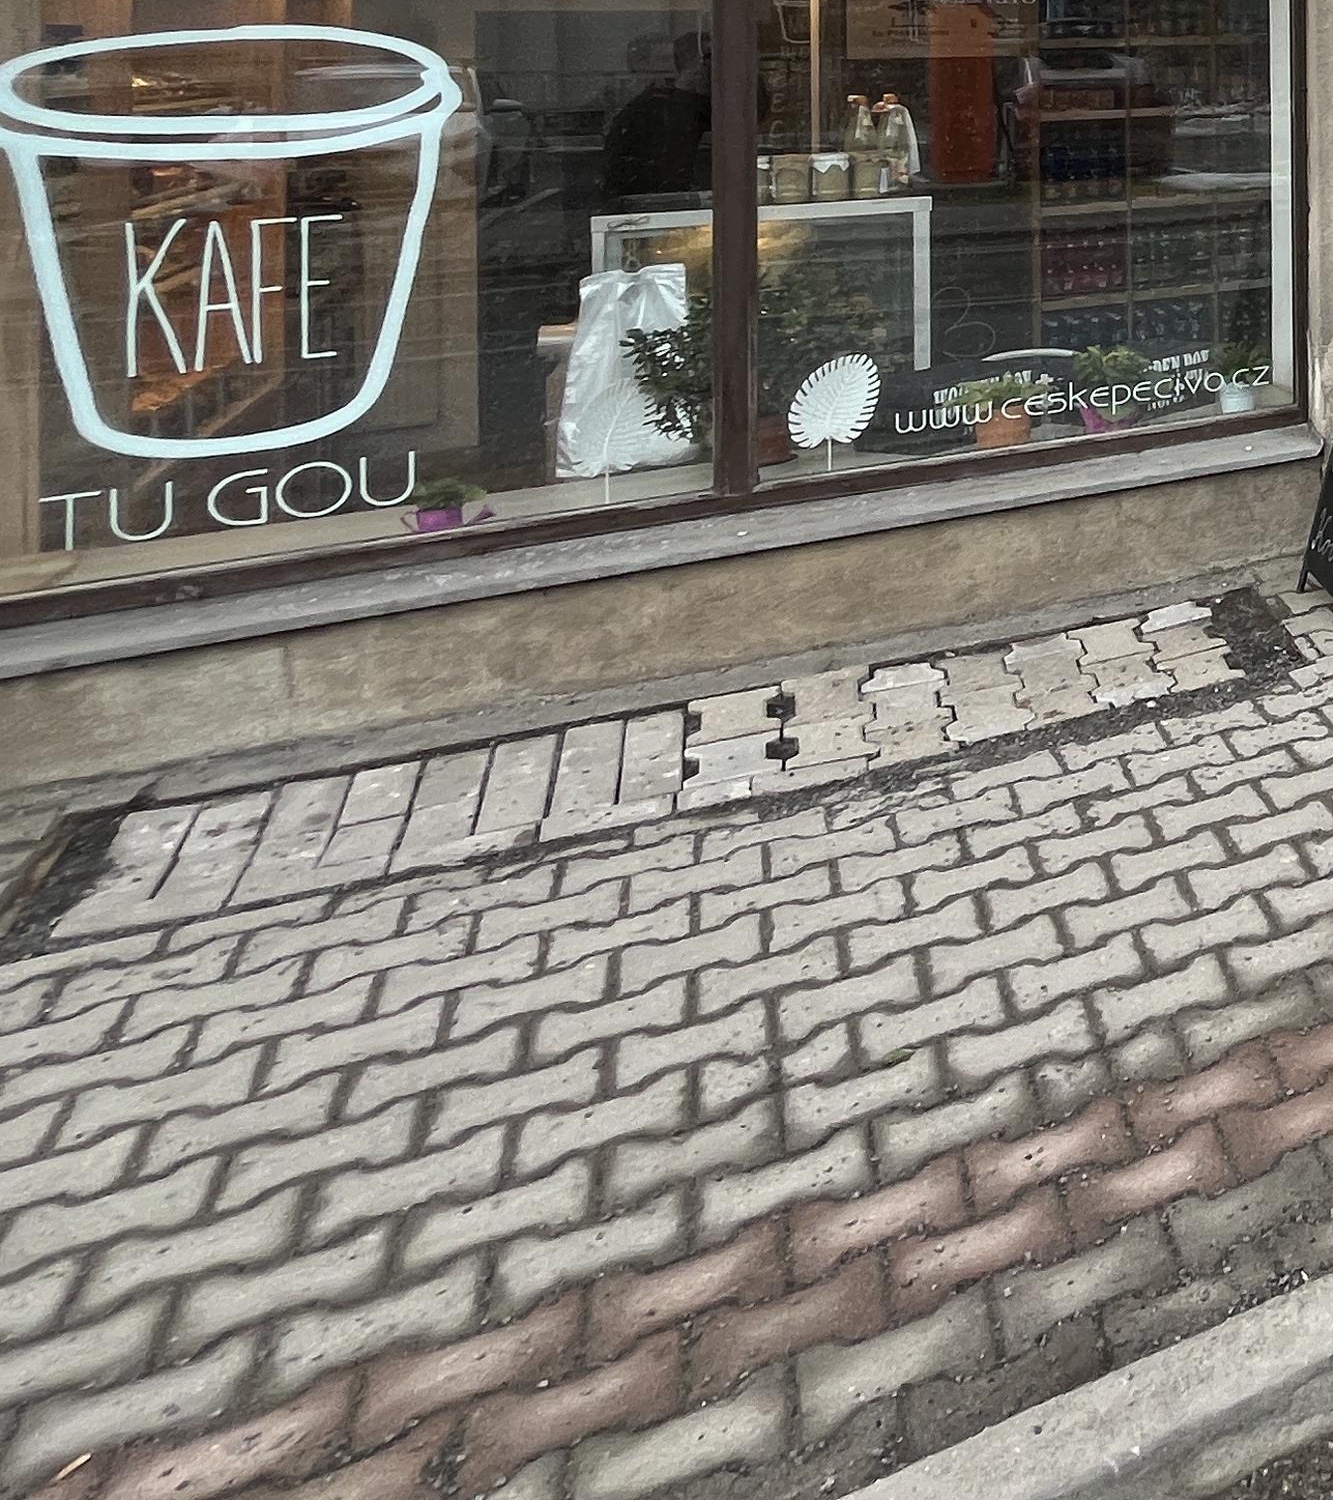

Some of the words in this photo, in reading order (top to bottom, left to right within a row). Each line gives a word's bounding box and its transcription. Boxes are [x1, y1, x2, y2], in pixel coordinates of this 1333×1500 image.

[124, 214, 343, 379] KAFE
[38, 479, 175, 551] TU
[207, 449, 418, 527] GOU
